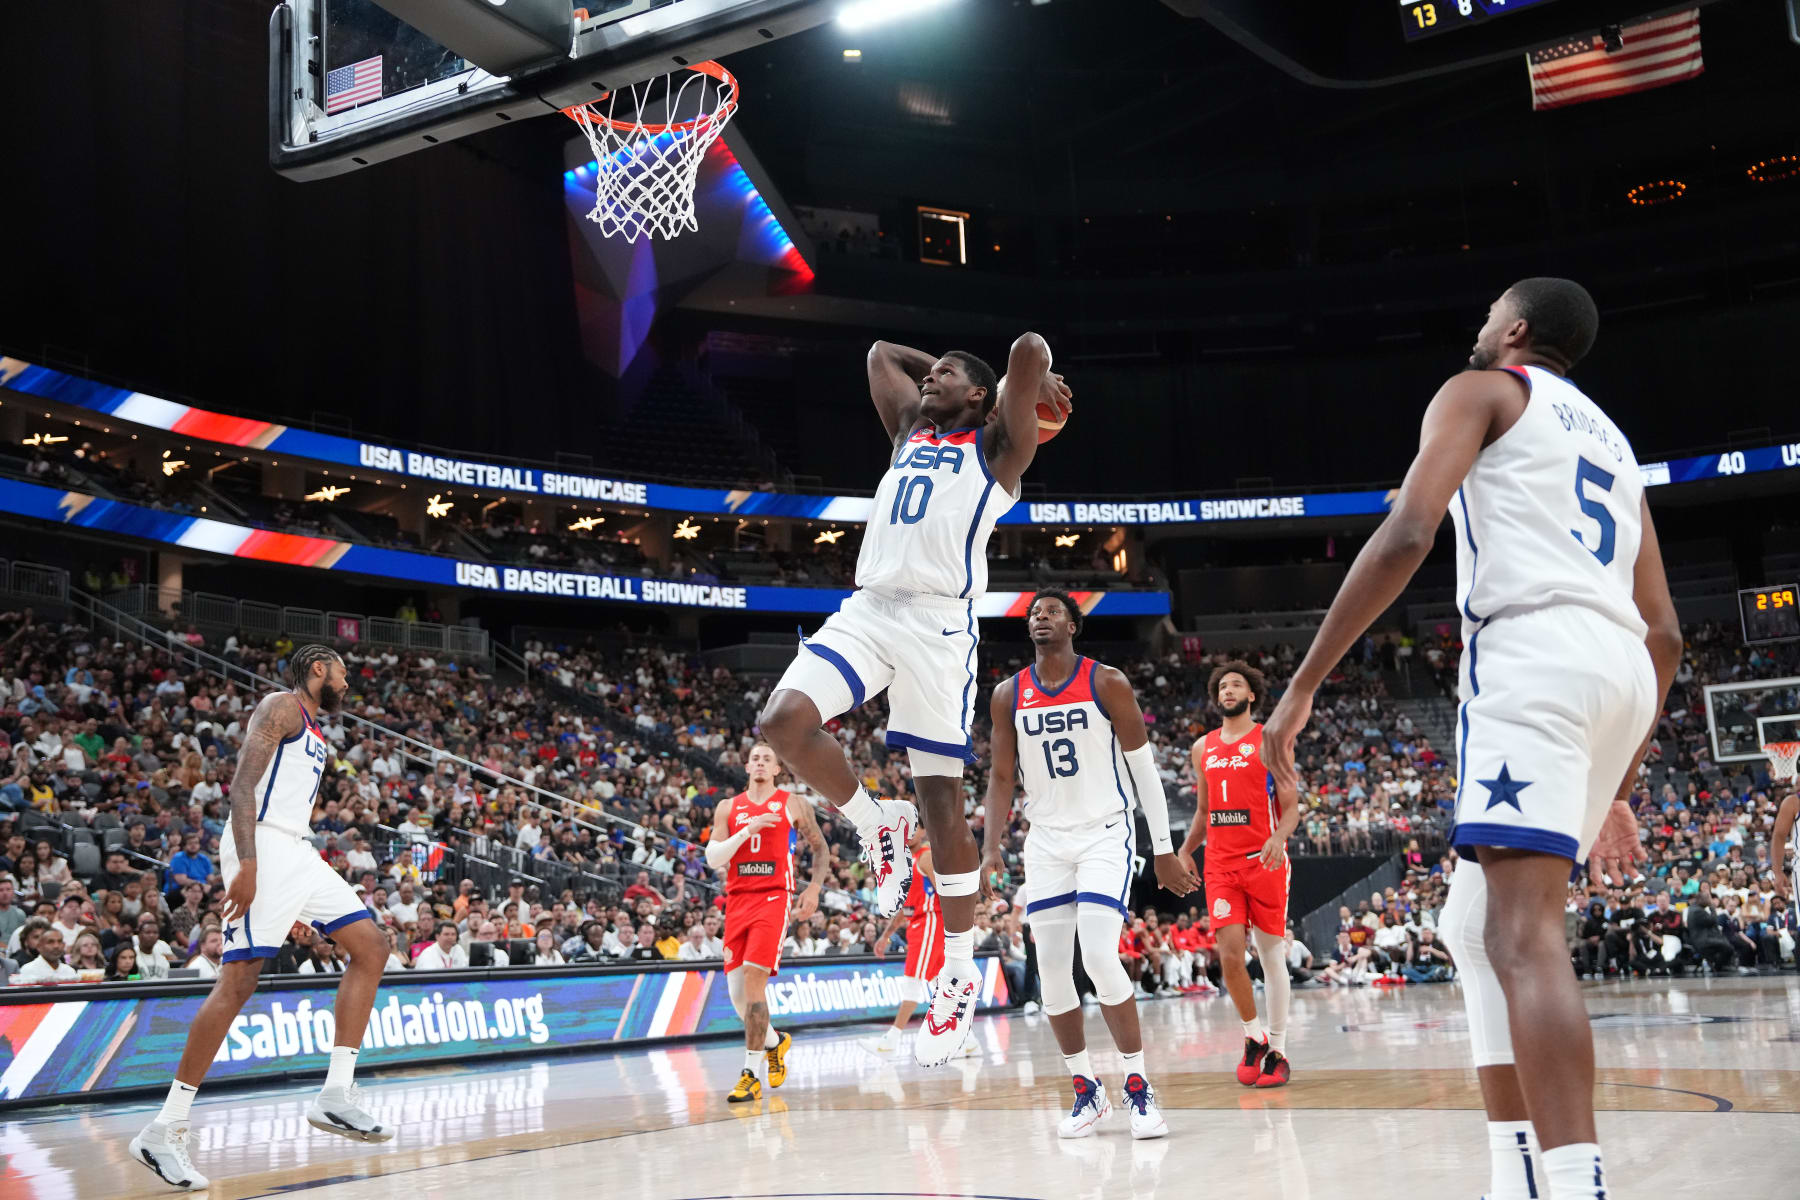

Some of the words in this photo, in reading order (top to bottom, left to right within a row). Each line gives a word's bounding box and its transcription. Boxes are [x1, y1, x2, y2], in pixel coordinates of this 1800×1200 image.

[1412, 3, 1437, 28] 13
[360, 443, 403, 473] USA
[407, 453, 538, 493] BASKETBALL
[542, 473, 647, 504] SHOWCASE
[893, 446, 965, 474] USA
[1717, 451, 1746, 475] 40
[890, 475, 934, 525] 10
[1029, 503, 1073, 523] USA
[1074, 501, 1197, 523] BASKETBALL
[1200, 497, 1305, 520] SHOWCASE
[1570, 454, 1616, 566] 5
[456, 562, 499, 589] USA
[503, 569, 637, 600] BASKETBALL
[641, 581, 747, 608] SHOWCASE
[1022, 708, 1088, 736] USA
[305, 734, 327, 763] US
[1042, 738, 1079, 779] 13
[309, 766, 321, 804] 7
[1221, 780, 1228, 802] 1
[1217, 812, 1247, 824] Mobile
[750, 833, 761, 854] 0
[742, 863, 773, 874] Mobile
[213, 992, 550, 1063] sabfondation.org
